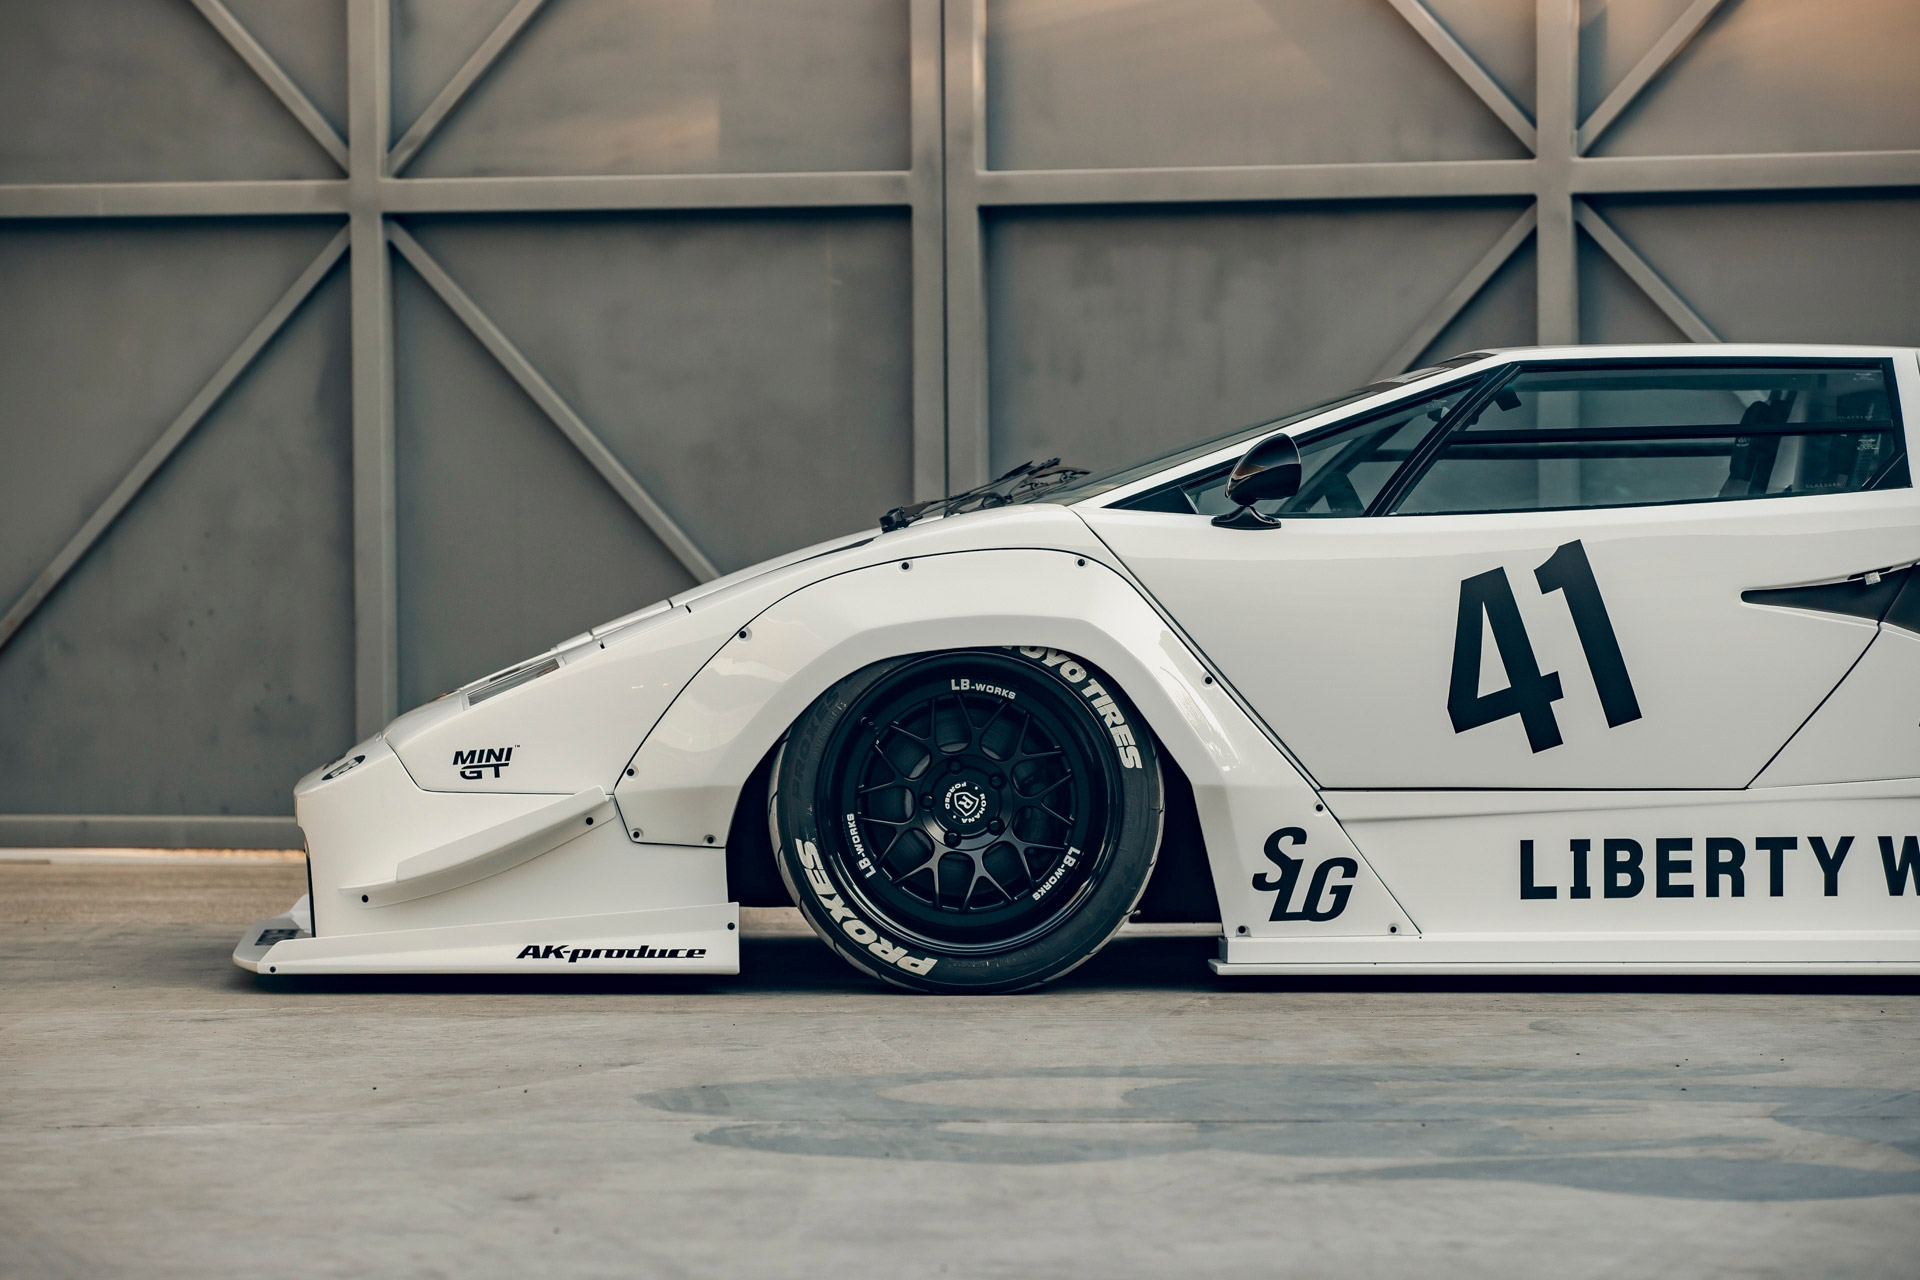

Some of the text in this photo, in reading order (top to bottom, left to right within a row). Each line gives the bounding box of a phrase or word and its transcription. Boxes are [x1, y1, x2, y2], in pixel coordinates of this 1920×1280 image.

[1446, 538, 1643, 755] 41
[950, 678, 1016, 700] LB-WORKS
[1002, 646, 1143, 769] OYO TIRES
[452, 746, 513, 766] MINI
[460, 762, 510, 780] GT
[791, 690, 840, 800] PROXES
[944, 781, 967, 810] FORGED
[957, 795, 975, 810] R
[961, 793, 987, 824] ROHANA
[846, 813, 877, 879] LB-WORKS
[1032, 846, 1081, 901] LB-WORKS
[1519, 835, 1920, 900] LIBERTY W
[1251, 826, 1359, 922] SLG
[795, 838, 938, 976] PROXES
[516, 944, 707, 963] AK-produce
